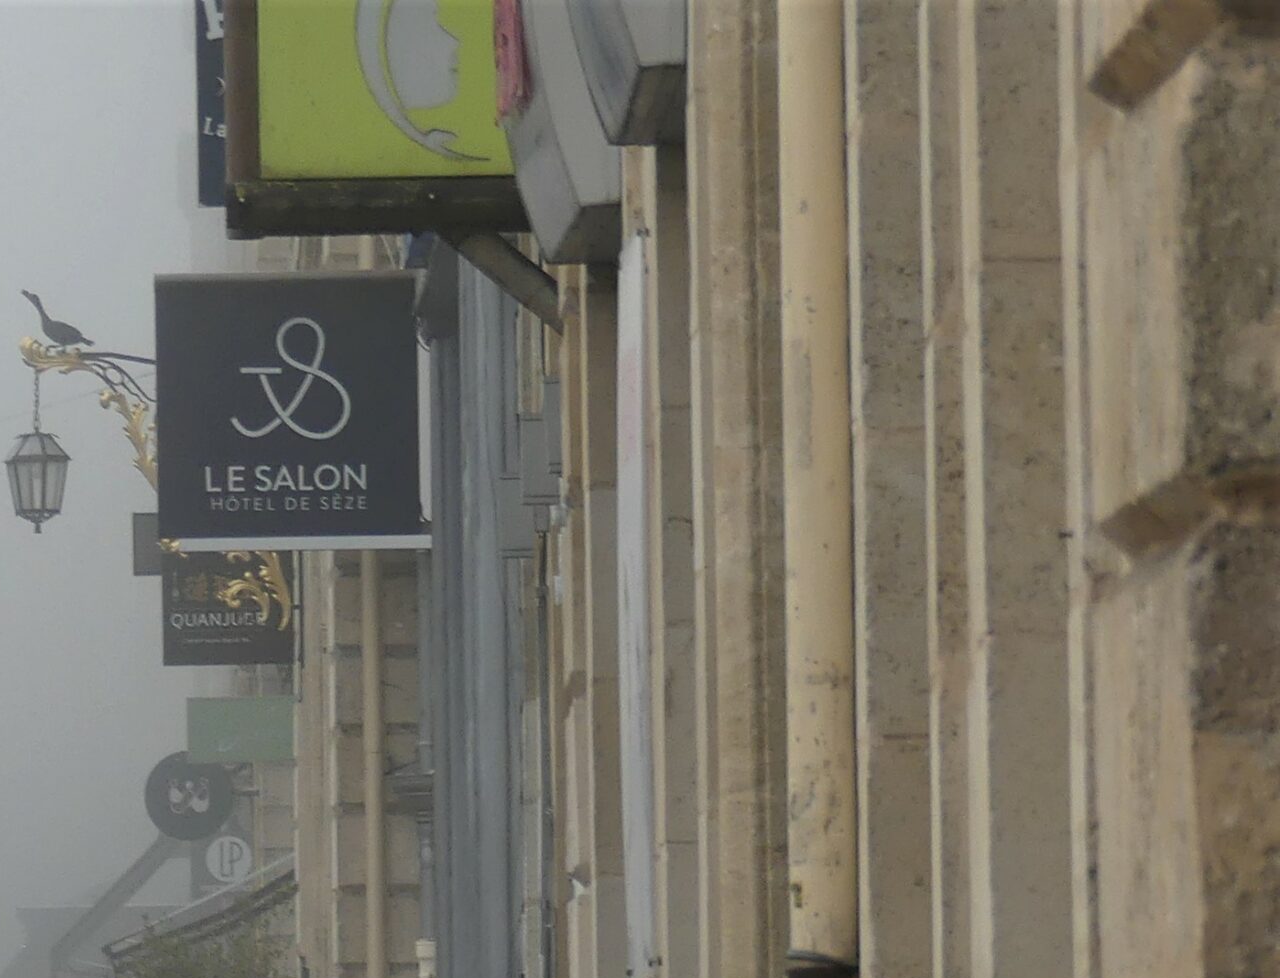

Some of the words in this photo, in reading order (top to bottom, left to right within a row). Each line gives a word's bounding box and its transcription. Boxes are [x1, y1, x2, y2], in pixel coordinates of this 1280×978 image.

[204, 465, 246, 492] LE
[254, 463, 368, 492] SALON
[210, 495, 276, 511] HÔTEL
[284, 496, 311, 511] DE
